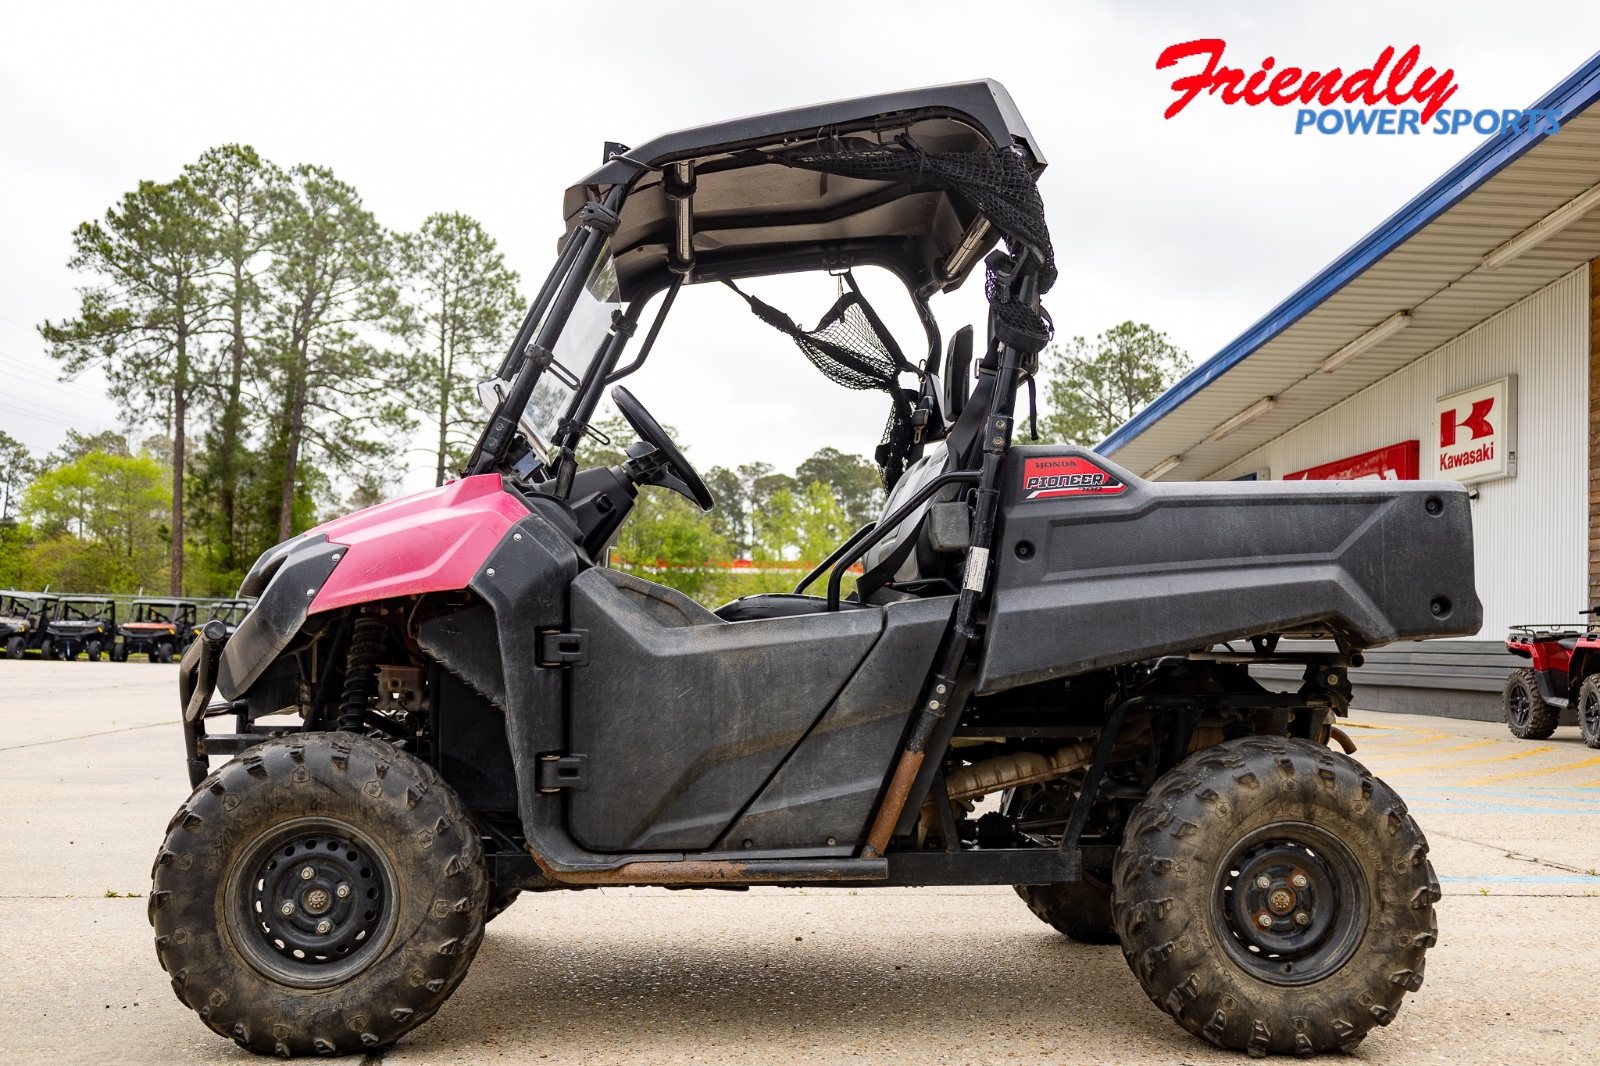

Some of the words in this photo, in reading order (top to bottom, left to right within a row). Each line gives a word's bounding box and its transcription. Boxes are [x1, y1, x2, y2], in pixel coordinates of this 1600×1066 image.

[1439, 441, 1494, 471] Kawasaki
[1035, 461, 1077, 469] HONDA
[1026, 473, 1105, 489] PIONEER
